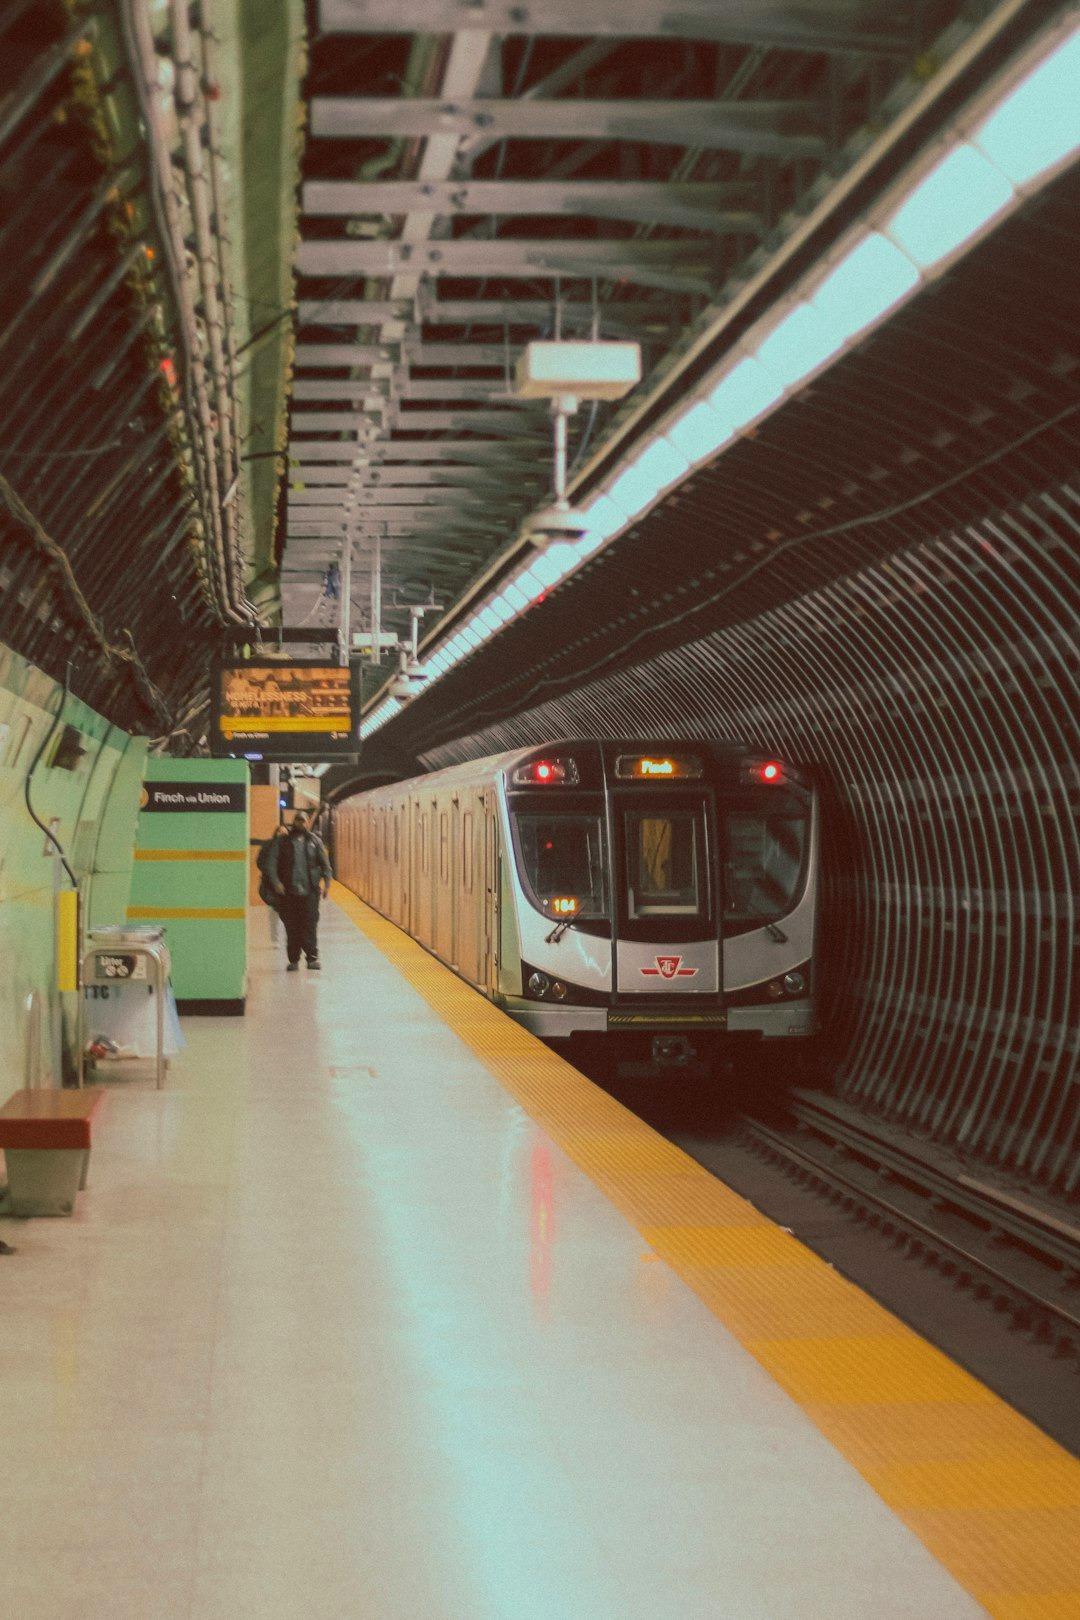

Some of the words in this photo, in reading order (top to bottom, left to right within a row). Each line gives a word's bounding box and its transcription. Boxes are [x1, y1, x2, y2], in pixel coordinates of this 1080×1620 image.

[641, 760, 673, 774] Finch
[154, 791, 185, 803] Finch
[185, 795, 197, 803] via
[197, 792, 231, 804] Union
